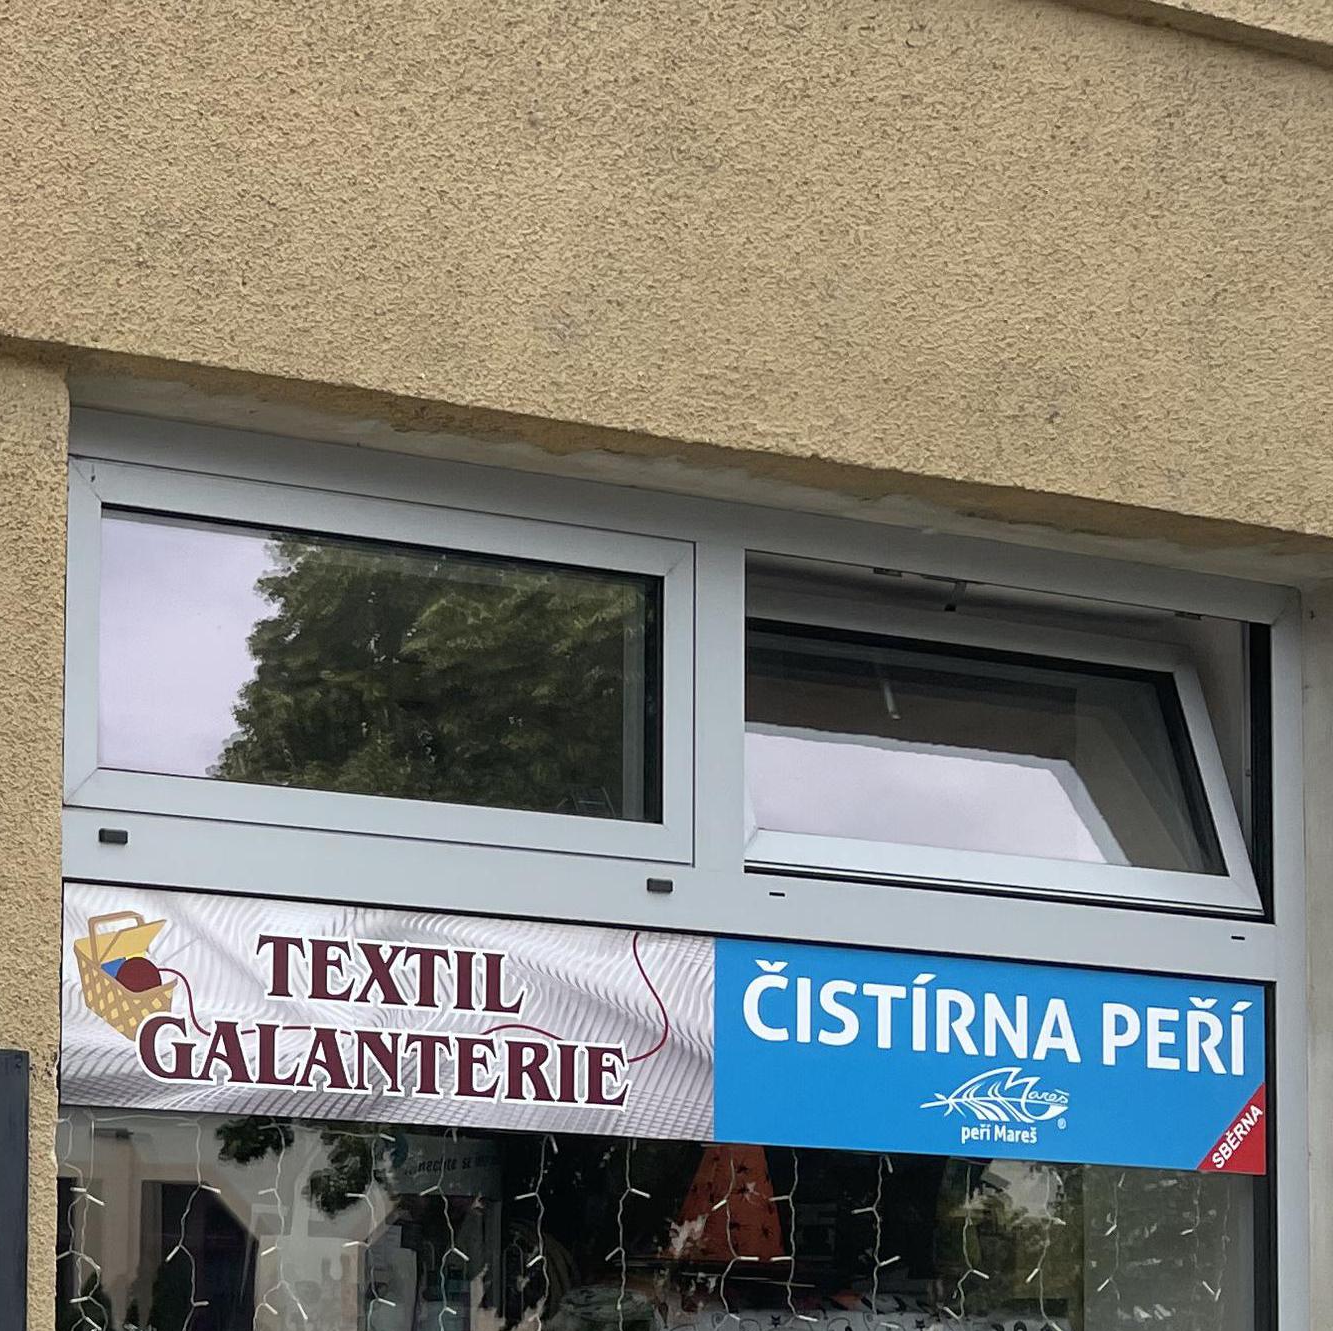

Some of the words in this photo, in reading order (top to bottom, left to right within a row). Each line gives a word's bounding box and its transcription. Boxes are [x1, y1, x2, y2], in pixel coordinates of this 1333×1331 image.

[258, 934, 526, 1014] TEXTIL
[743, 959, 1081, 1064] ČISTÍRNA
[1102, 997, 1253, 1076] PEŘÍ
[139, 1017, 629, 1109] GALANTERIE
[961, 1123, 992, 1145] peří
[994, 1124, 1038, 1144] Mareš
[1211, 1104, 1264, 1170] SBĚRNA
